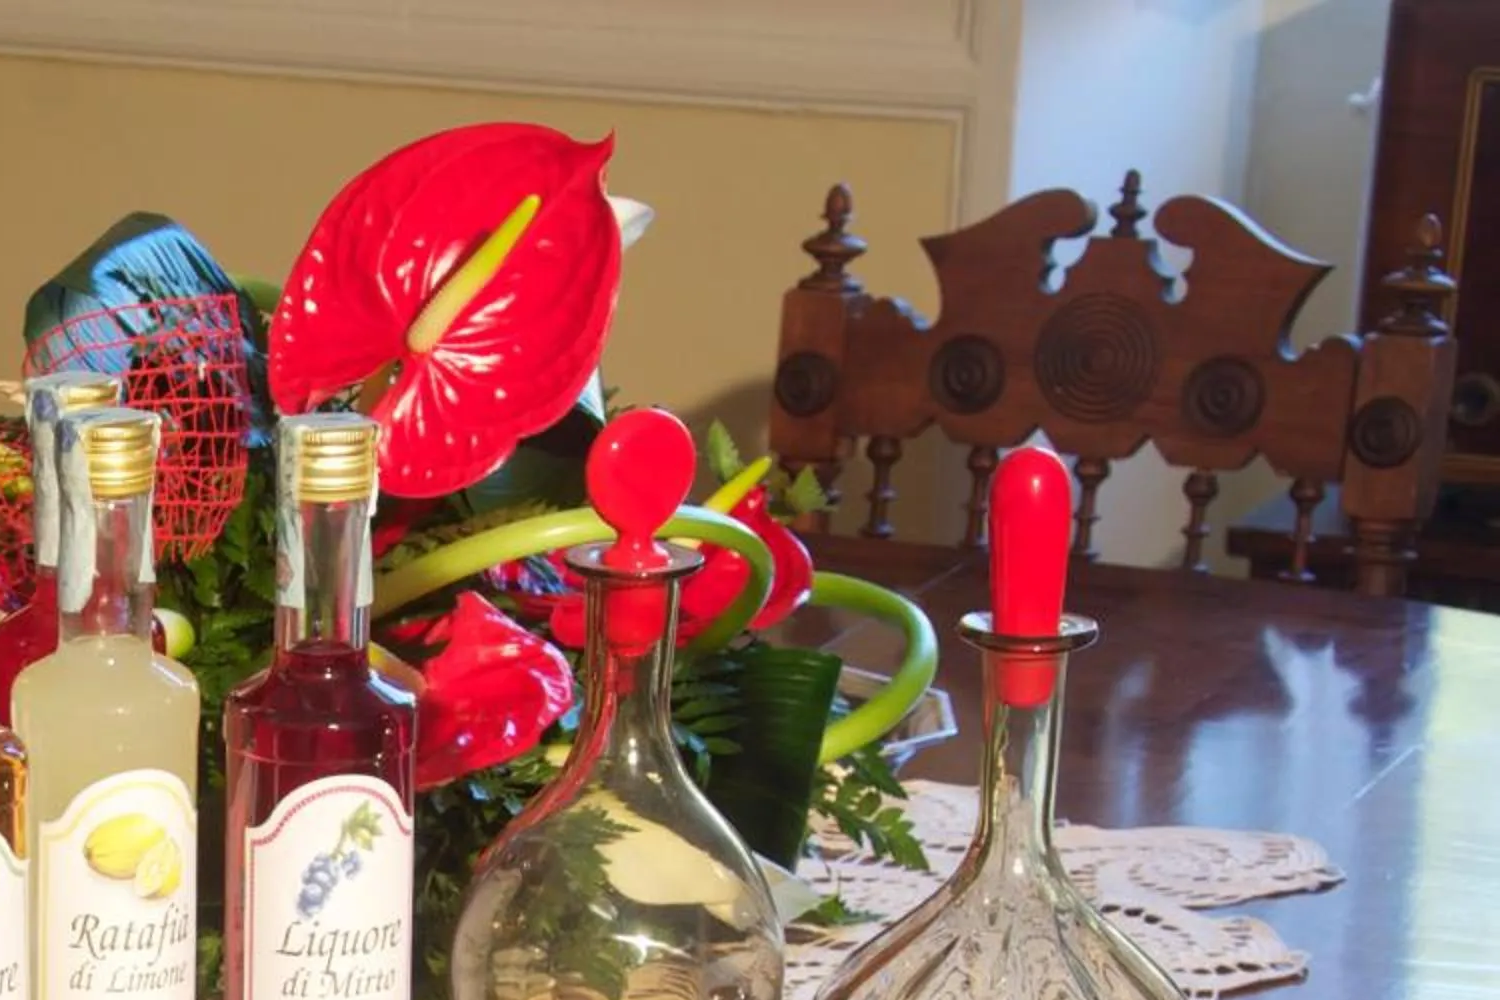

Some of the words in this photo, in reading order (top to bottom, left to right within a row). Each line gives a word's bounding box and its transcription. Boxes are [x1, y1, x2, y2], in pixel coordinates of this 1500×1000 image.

[275, 917, 402, 975] Liquore
[68, 958, 97, 992] di
[281, 966, 312, 998] di
[317, 965, 396, 999] Mirto
